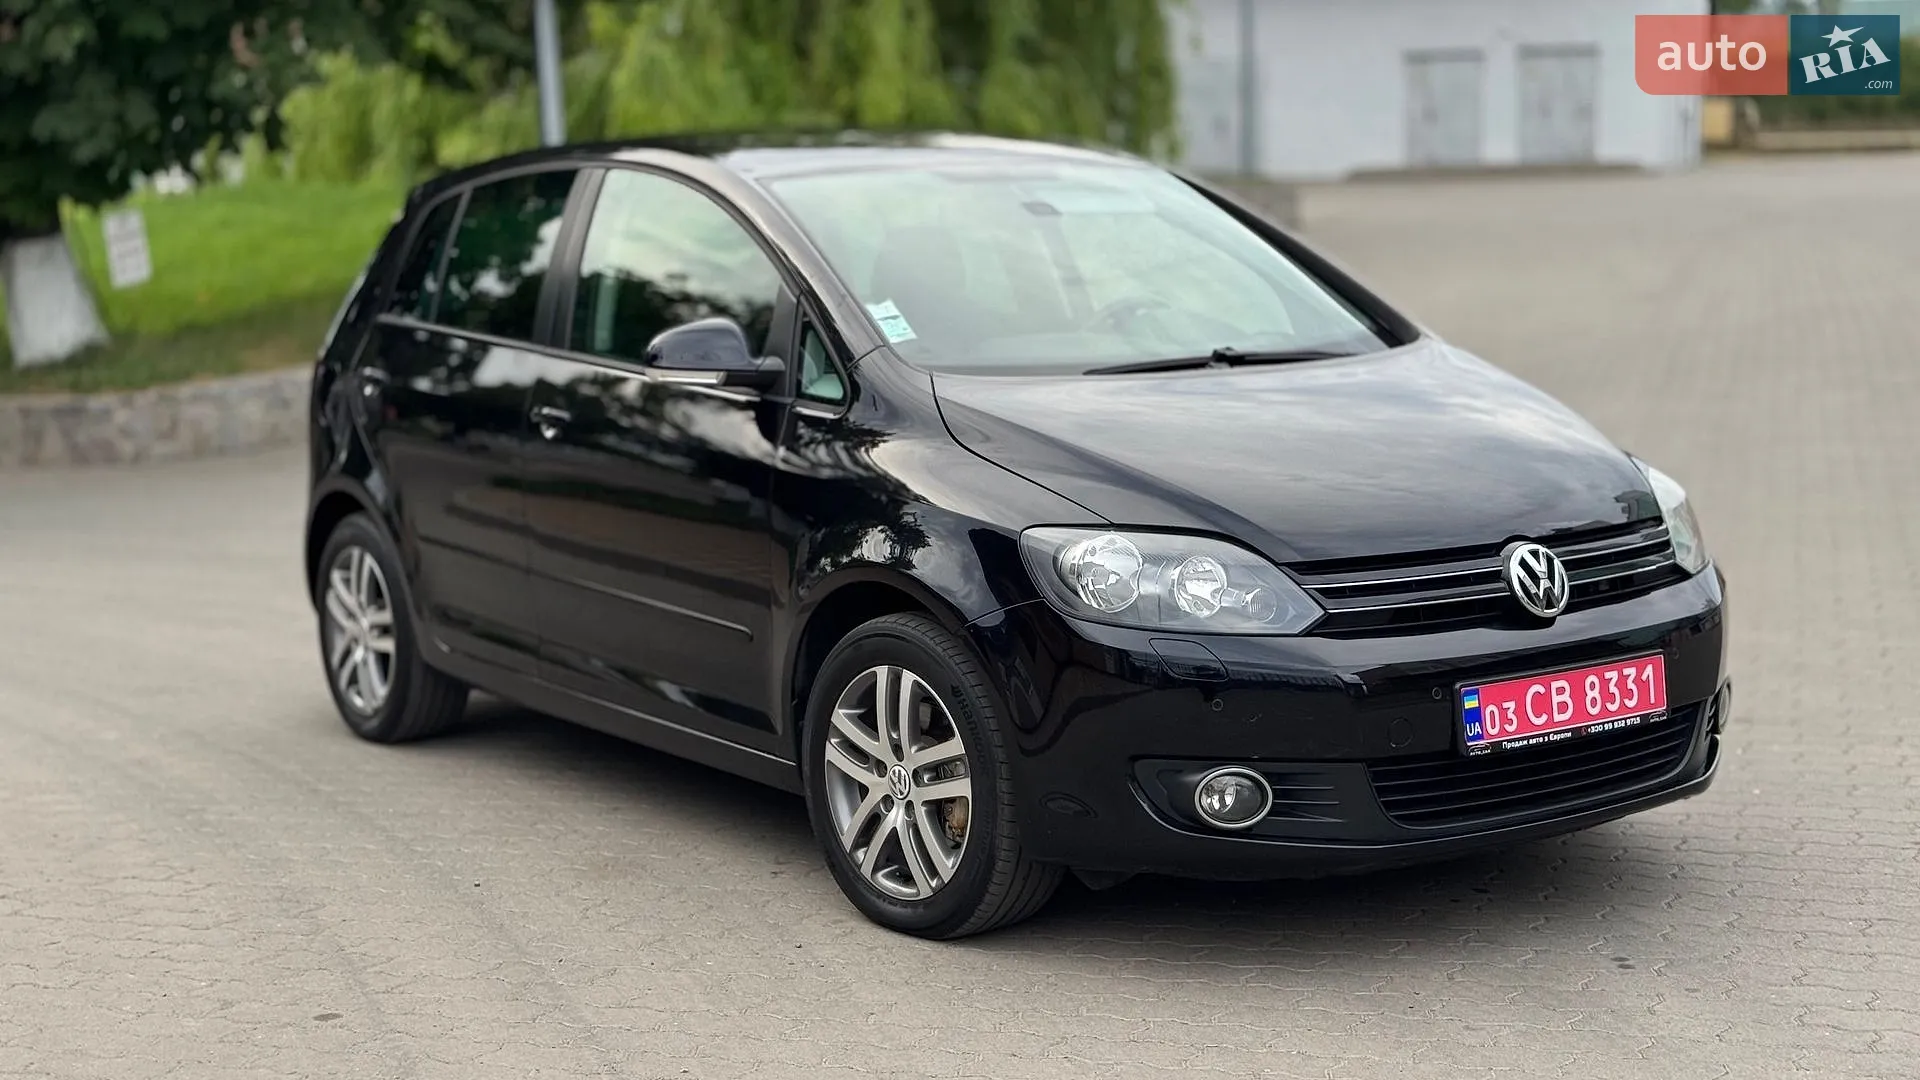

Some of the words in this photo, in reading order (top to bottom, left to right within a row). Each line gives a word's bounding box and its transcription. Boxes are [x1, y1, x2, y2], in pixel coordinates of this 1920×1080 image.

[1484, 700, 1518, 736] 03
[1525, 679, 1574, 726] CB
[1584, 663, 1656, 716] 8331
[1466, 721, 1482, 737] UA
[1502, 739, 1528, 749] Продаж
[1529, 736, 1543, 745] авто
